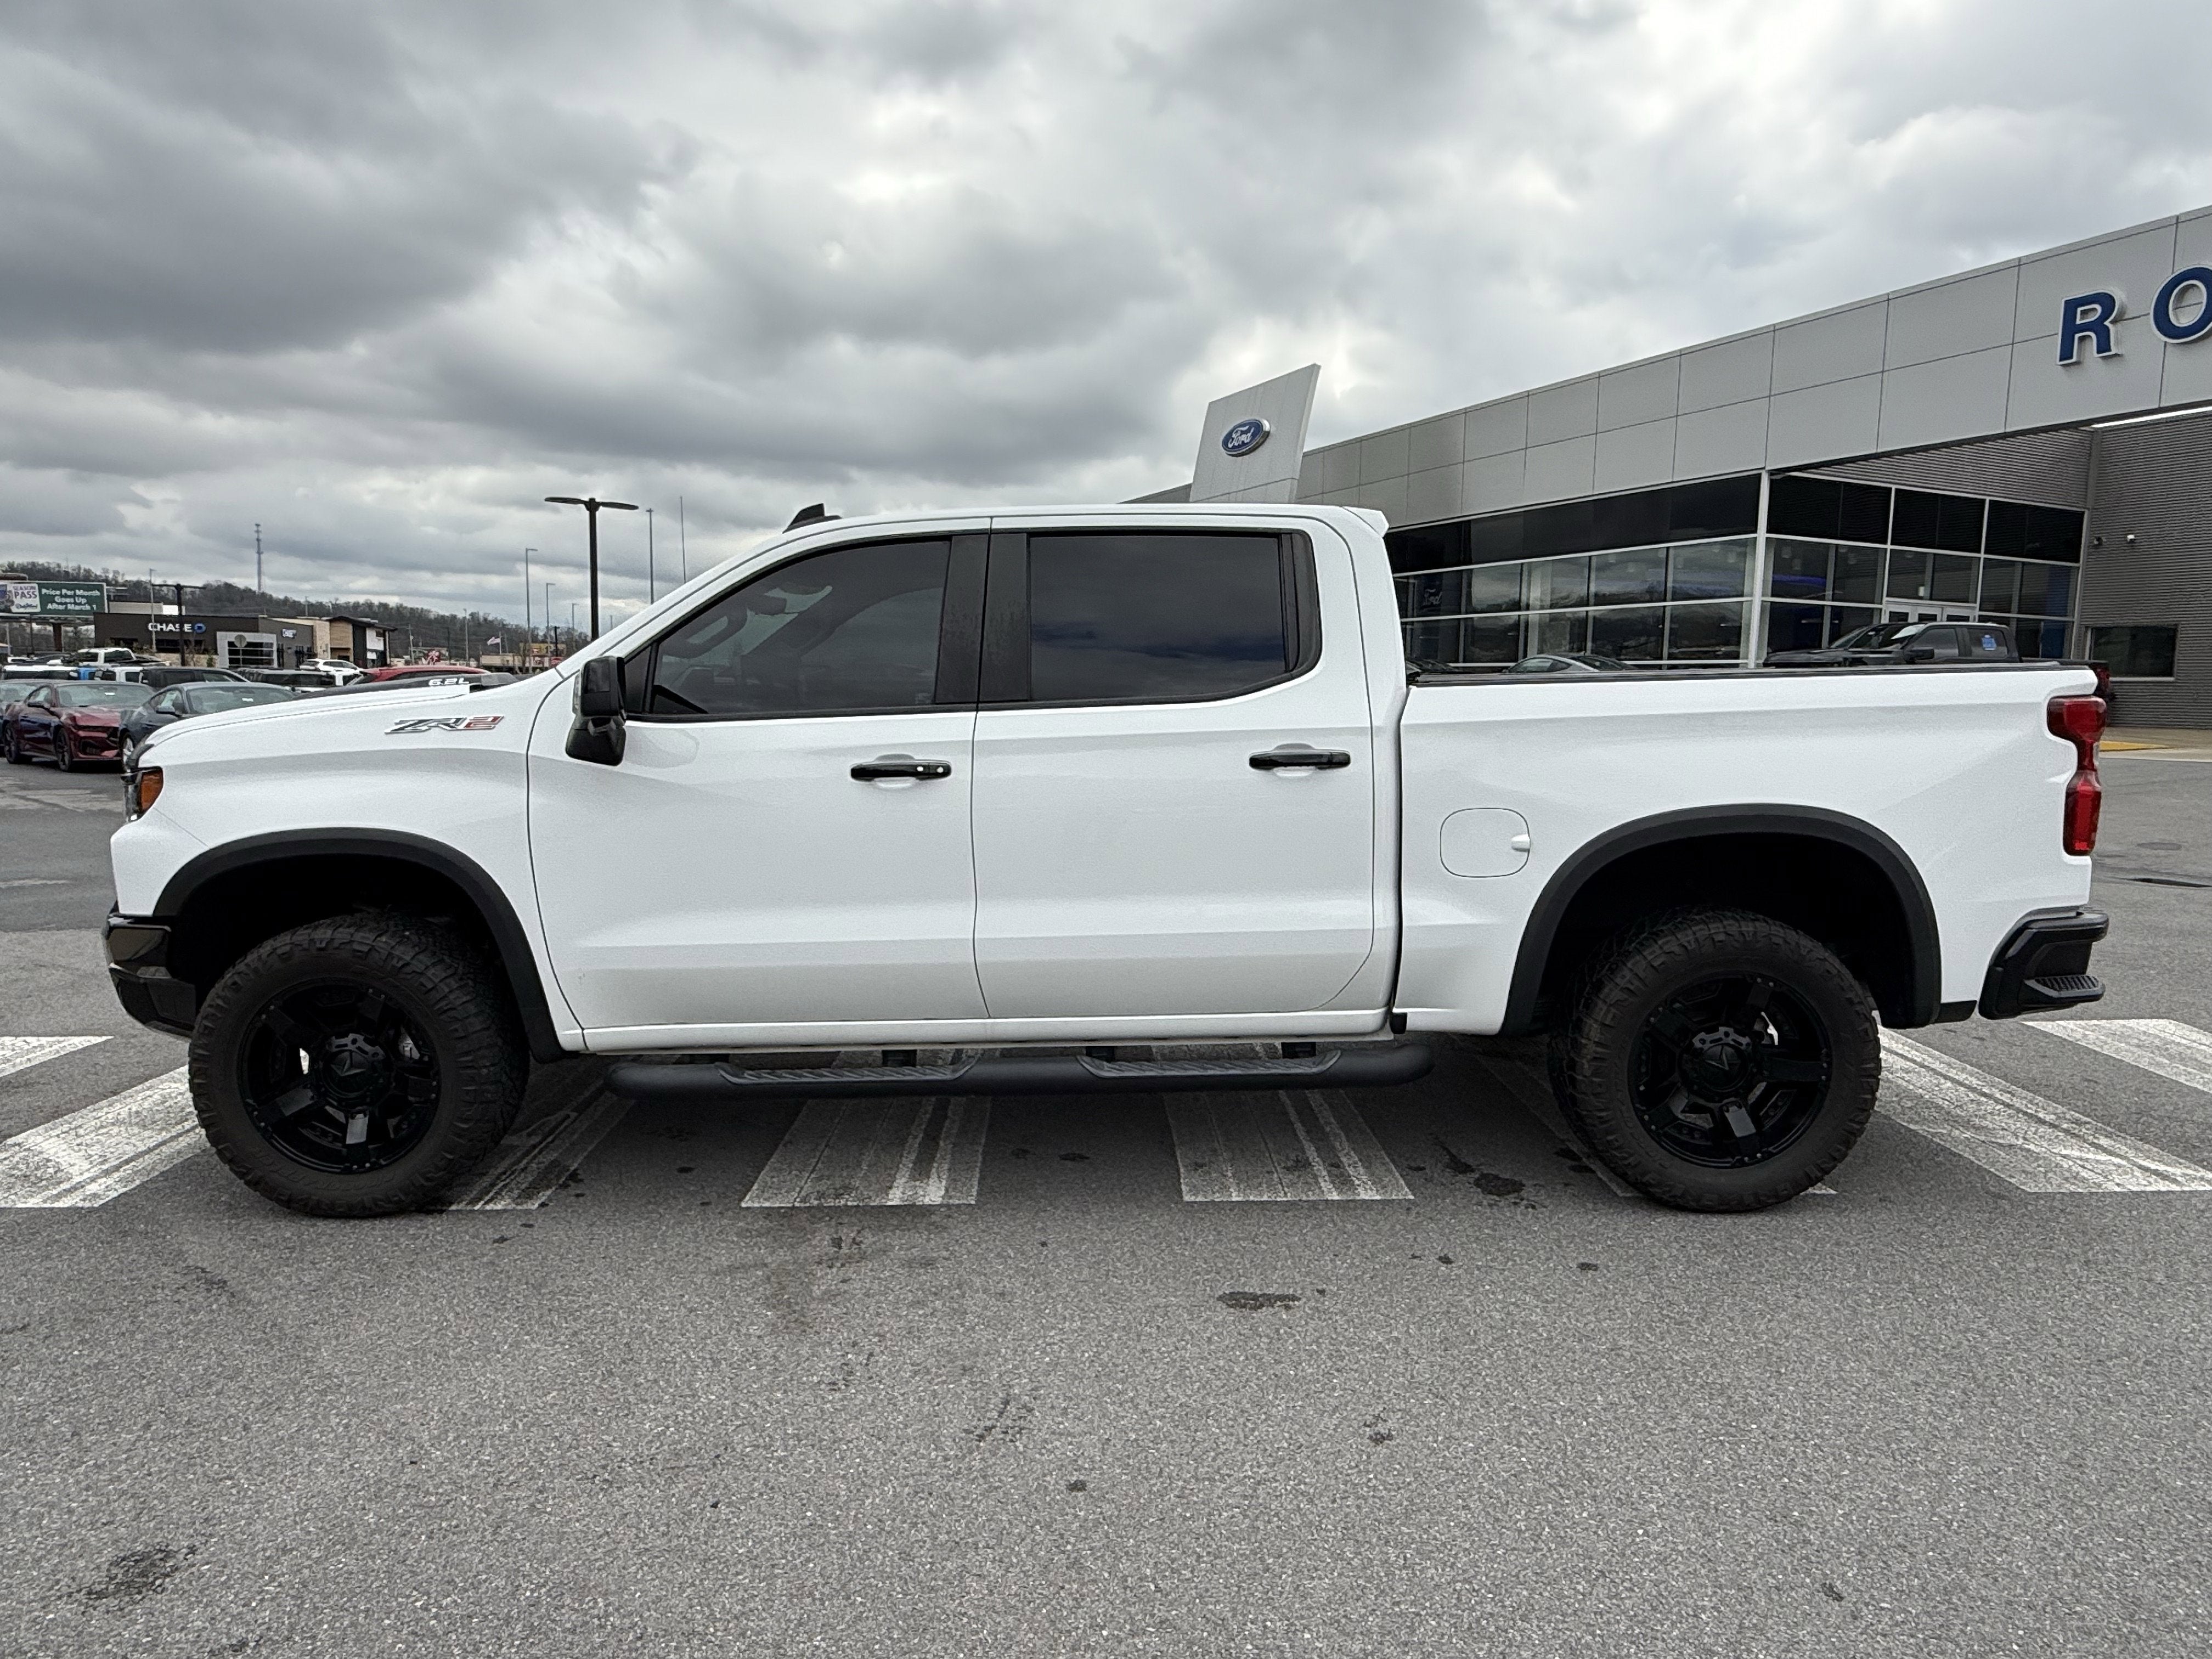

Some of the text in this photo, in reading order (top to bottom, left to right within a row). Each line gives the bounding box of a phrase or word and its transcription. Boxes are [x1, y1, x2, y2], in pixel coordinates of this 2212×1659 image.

[2057, 266, 2212, 365] RO
[1228, 426, 1255, 449] Ford
[14, 590, 37, 599] PASS
[75, 596, 87, 605] Up
[428, 678, 470, 686] 6.2L
[384, 714, 505, 735] ZR2
